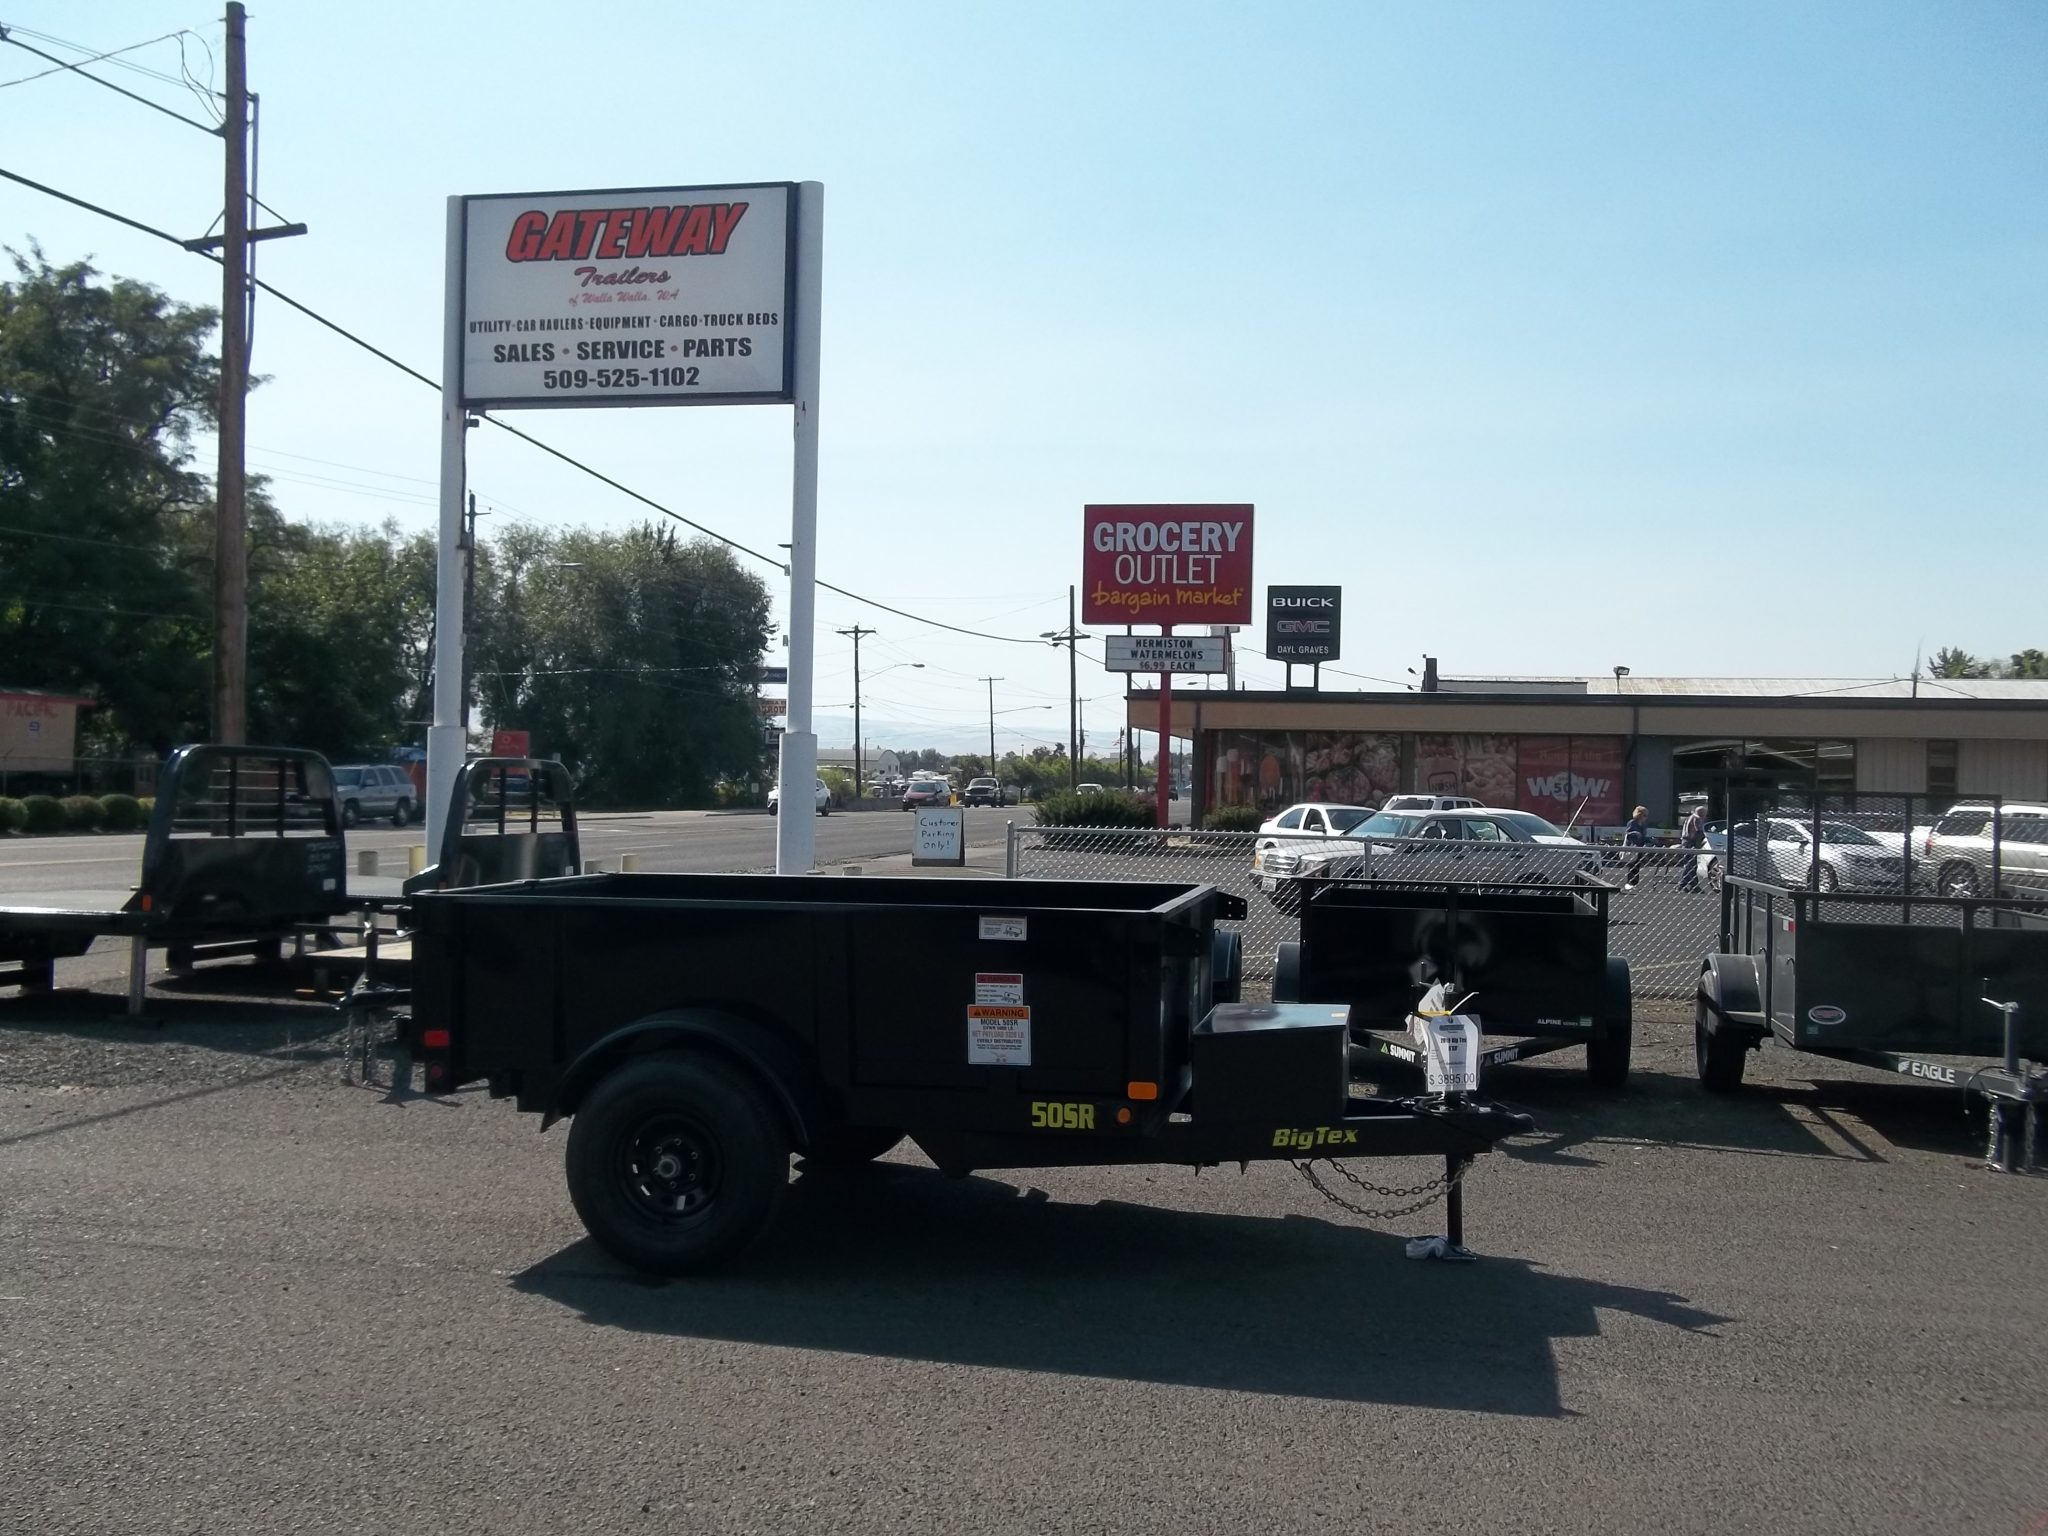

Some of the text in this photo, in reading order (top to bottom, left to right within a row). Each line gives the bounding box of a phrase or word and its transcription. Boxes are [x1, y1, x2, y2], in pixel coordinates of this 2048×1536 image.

[506, 203, 749, 262] GATEWAY
[574, 266, 671, 287] Trailers
[569, 294, 578, 307] of
[582, 293, 612, 304] Walla
[470, 313, 778, 333] UTILITY CAR HAULERS EQUIPMENT CARGO TRUCK BEDS
[494, 337, 752, 363] SALES SERVICE PARTS
[544, 367, 700, 389] 509-525-1102
[1093, 521, 1243, 552] GROCERY
[1115, 554, 1222, 584] OUTLET
[1091, 581, 1240, 614] bargain market
[1272, 597, 1334, 607] BUICK
[1277, 620, 1330, 633] GMC
[1135, 638, 1193, 649] HERMISTON
[1277, 645, 1329, 654] DAYL GRAVES
[1131, 650, 1203, 660] WATERMELONS
[1139, 661, 1195, 671] $6.99 EACH
[920, 817, 959, 827] Customer
[921, 830, 955, 840] Parking
[982, 1009, 1024, 1017] WARNING
[1390, 1044, 1415, 1063] SUMMIT
[1494, 1048, 1519, 1064] SUMMIT
[1438, 1072, 1475, 1084] 3895.00
[1912, 1062, 1955, 1083] EAGLE
[1032, 1102, 1095, 1129] 50SR
